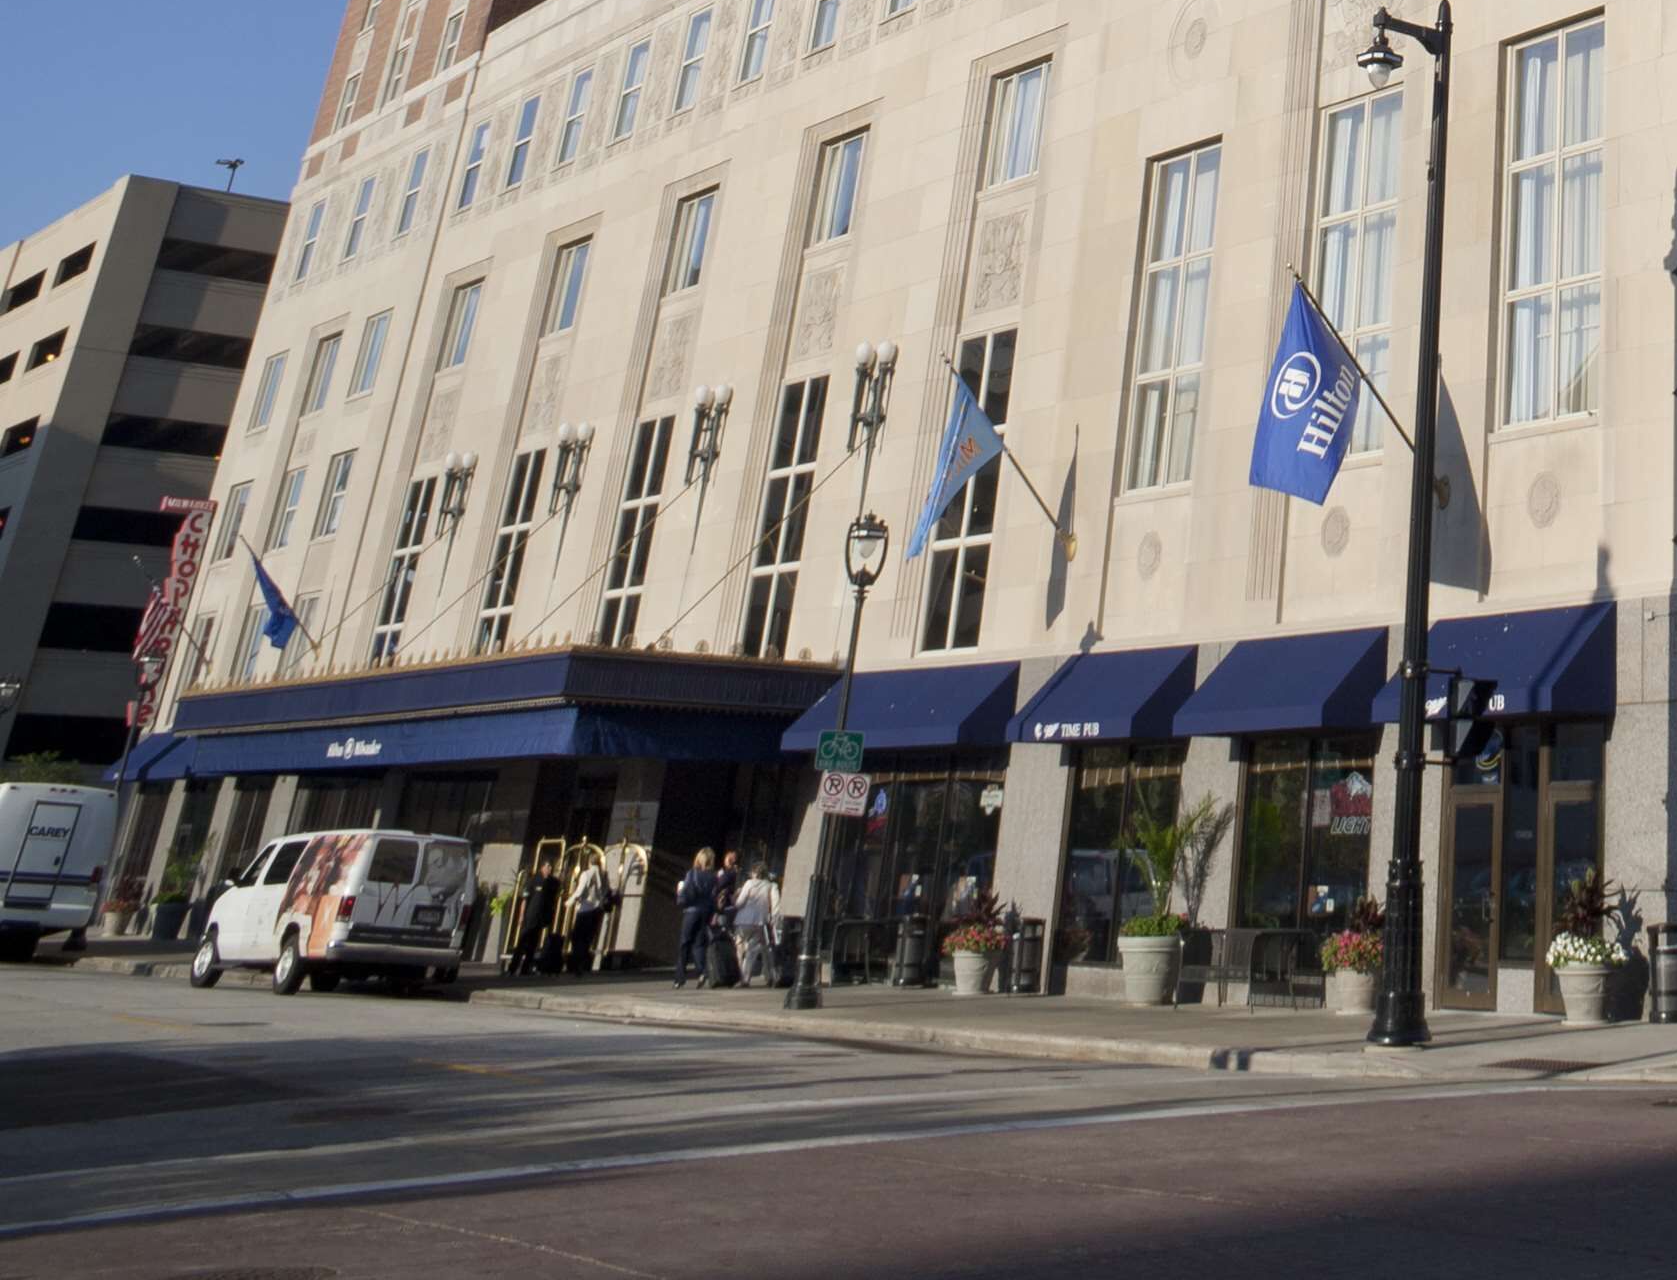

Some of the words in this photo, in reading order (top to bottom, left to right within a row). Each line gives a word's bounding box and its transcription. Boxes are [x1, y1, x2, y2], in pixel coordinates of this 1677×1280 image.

[1296, 364, 1356, 460] Hilton
[1061, 723, 1081, 738] TIME
[1083, 722, 1100, 737] PUB
[29, 825, 71, 838] CAREY
